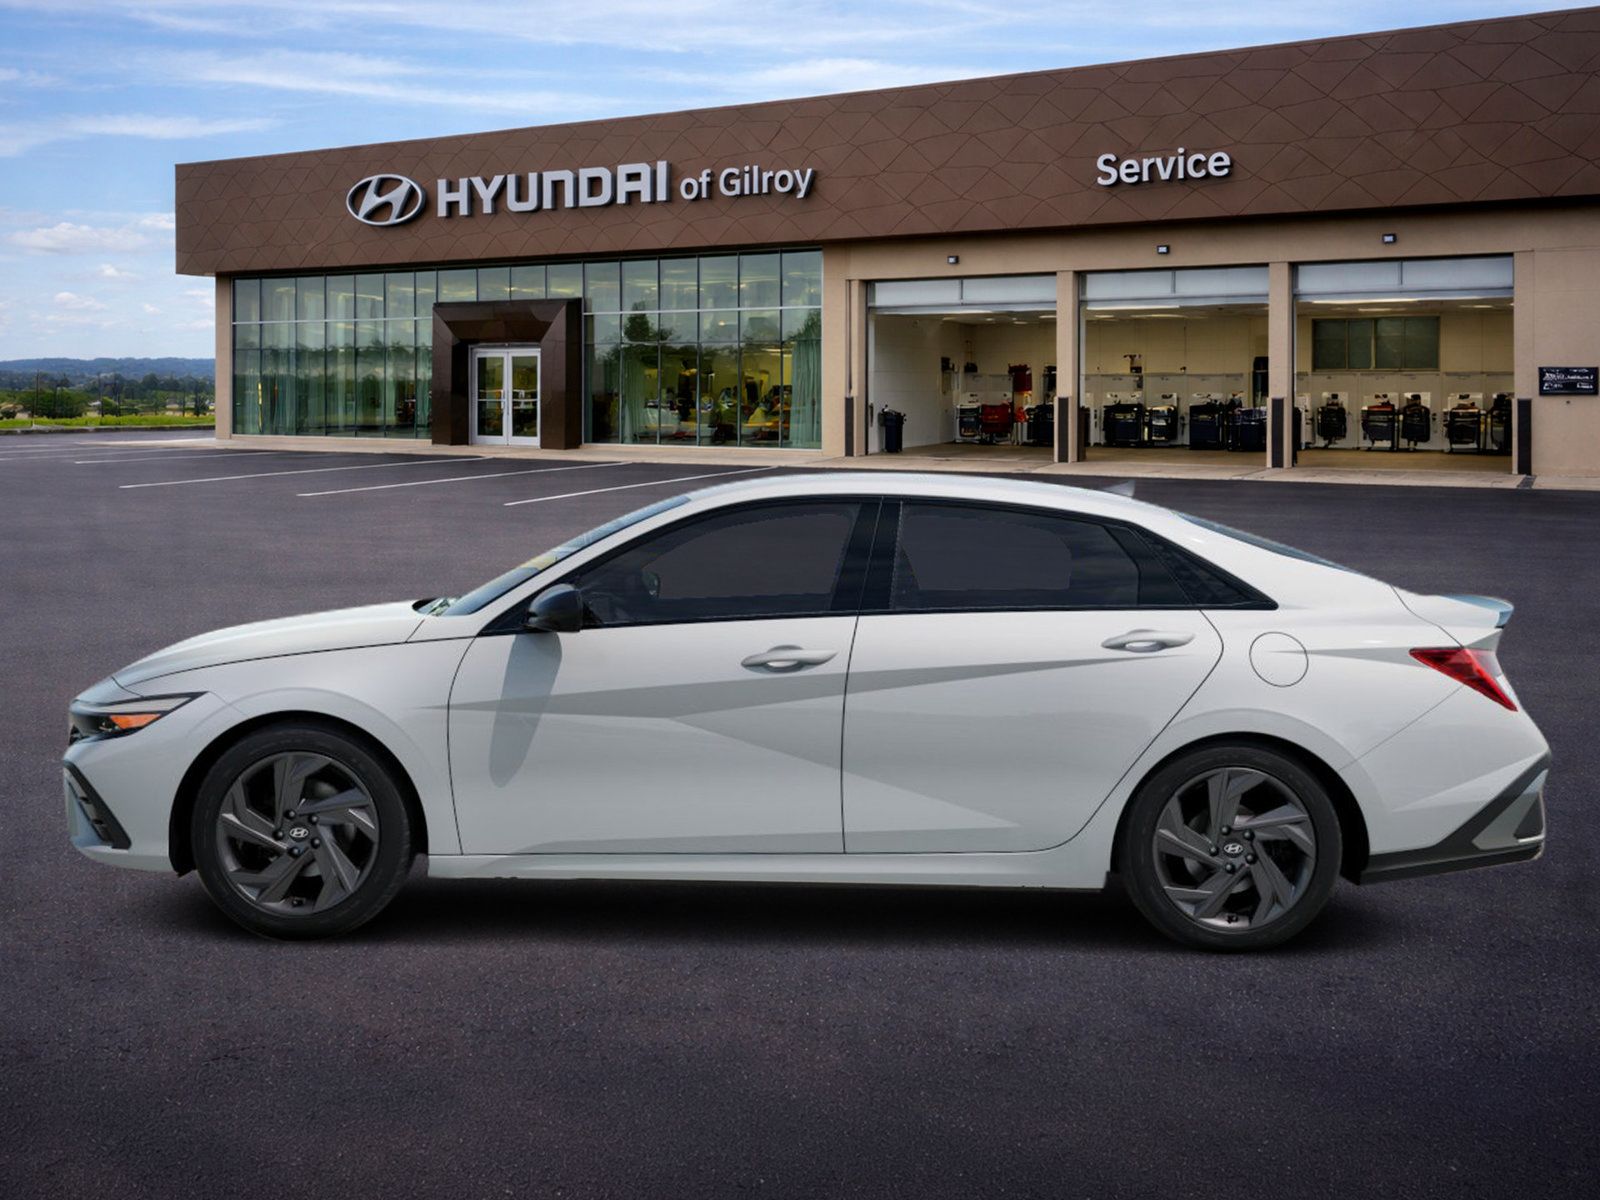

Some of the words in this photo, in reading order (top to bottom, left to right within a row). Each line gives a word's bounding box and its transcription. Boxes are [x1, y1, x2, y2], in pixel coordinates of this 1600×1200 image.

[437, 160, 668, 217] HYUNDAI
[680, 168, 712, 200] of
[719, 165, 813, 199] Gilroy
[1096, 147, 1231, 186] Service
